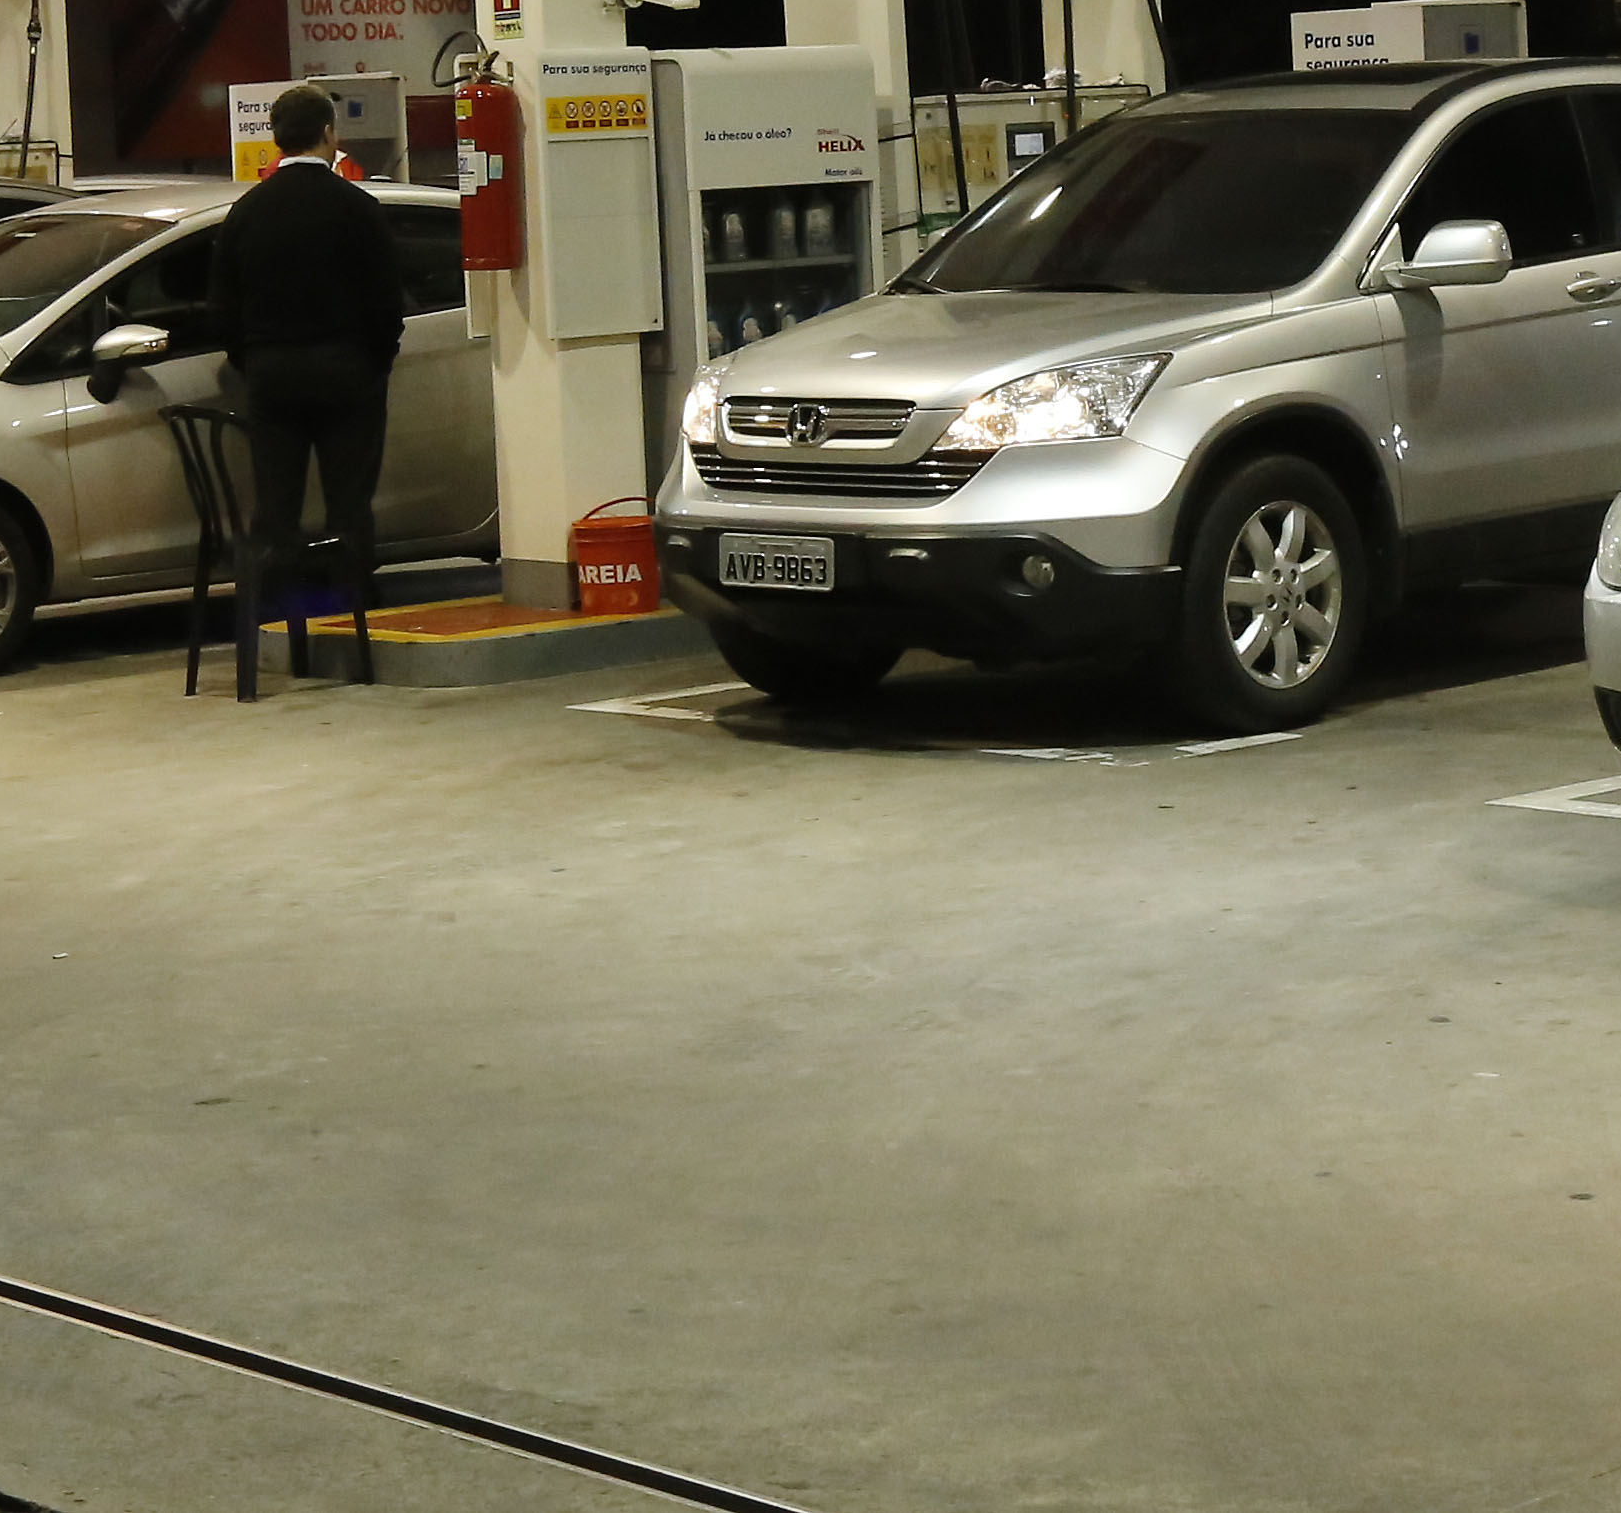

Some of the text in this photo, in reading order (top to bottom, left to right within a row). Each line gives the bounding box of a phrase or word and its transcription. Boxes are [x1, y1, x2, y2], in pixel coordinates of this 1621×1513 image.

[302, 22, 358, 41] TODO
[1305, 32, 1374, 49] Para sua
[543, 63, 647, 77] Para sua segurança
[237, 101, 260, 113] Para
[718, 129, 753, 140] checou
[817, 139, 865, 153] HELIX
[726, 553, 827, 584] AVB-9863
